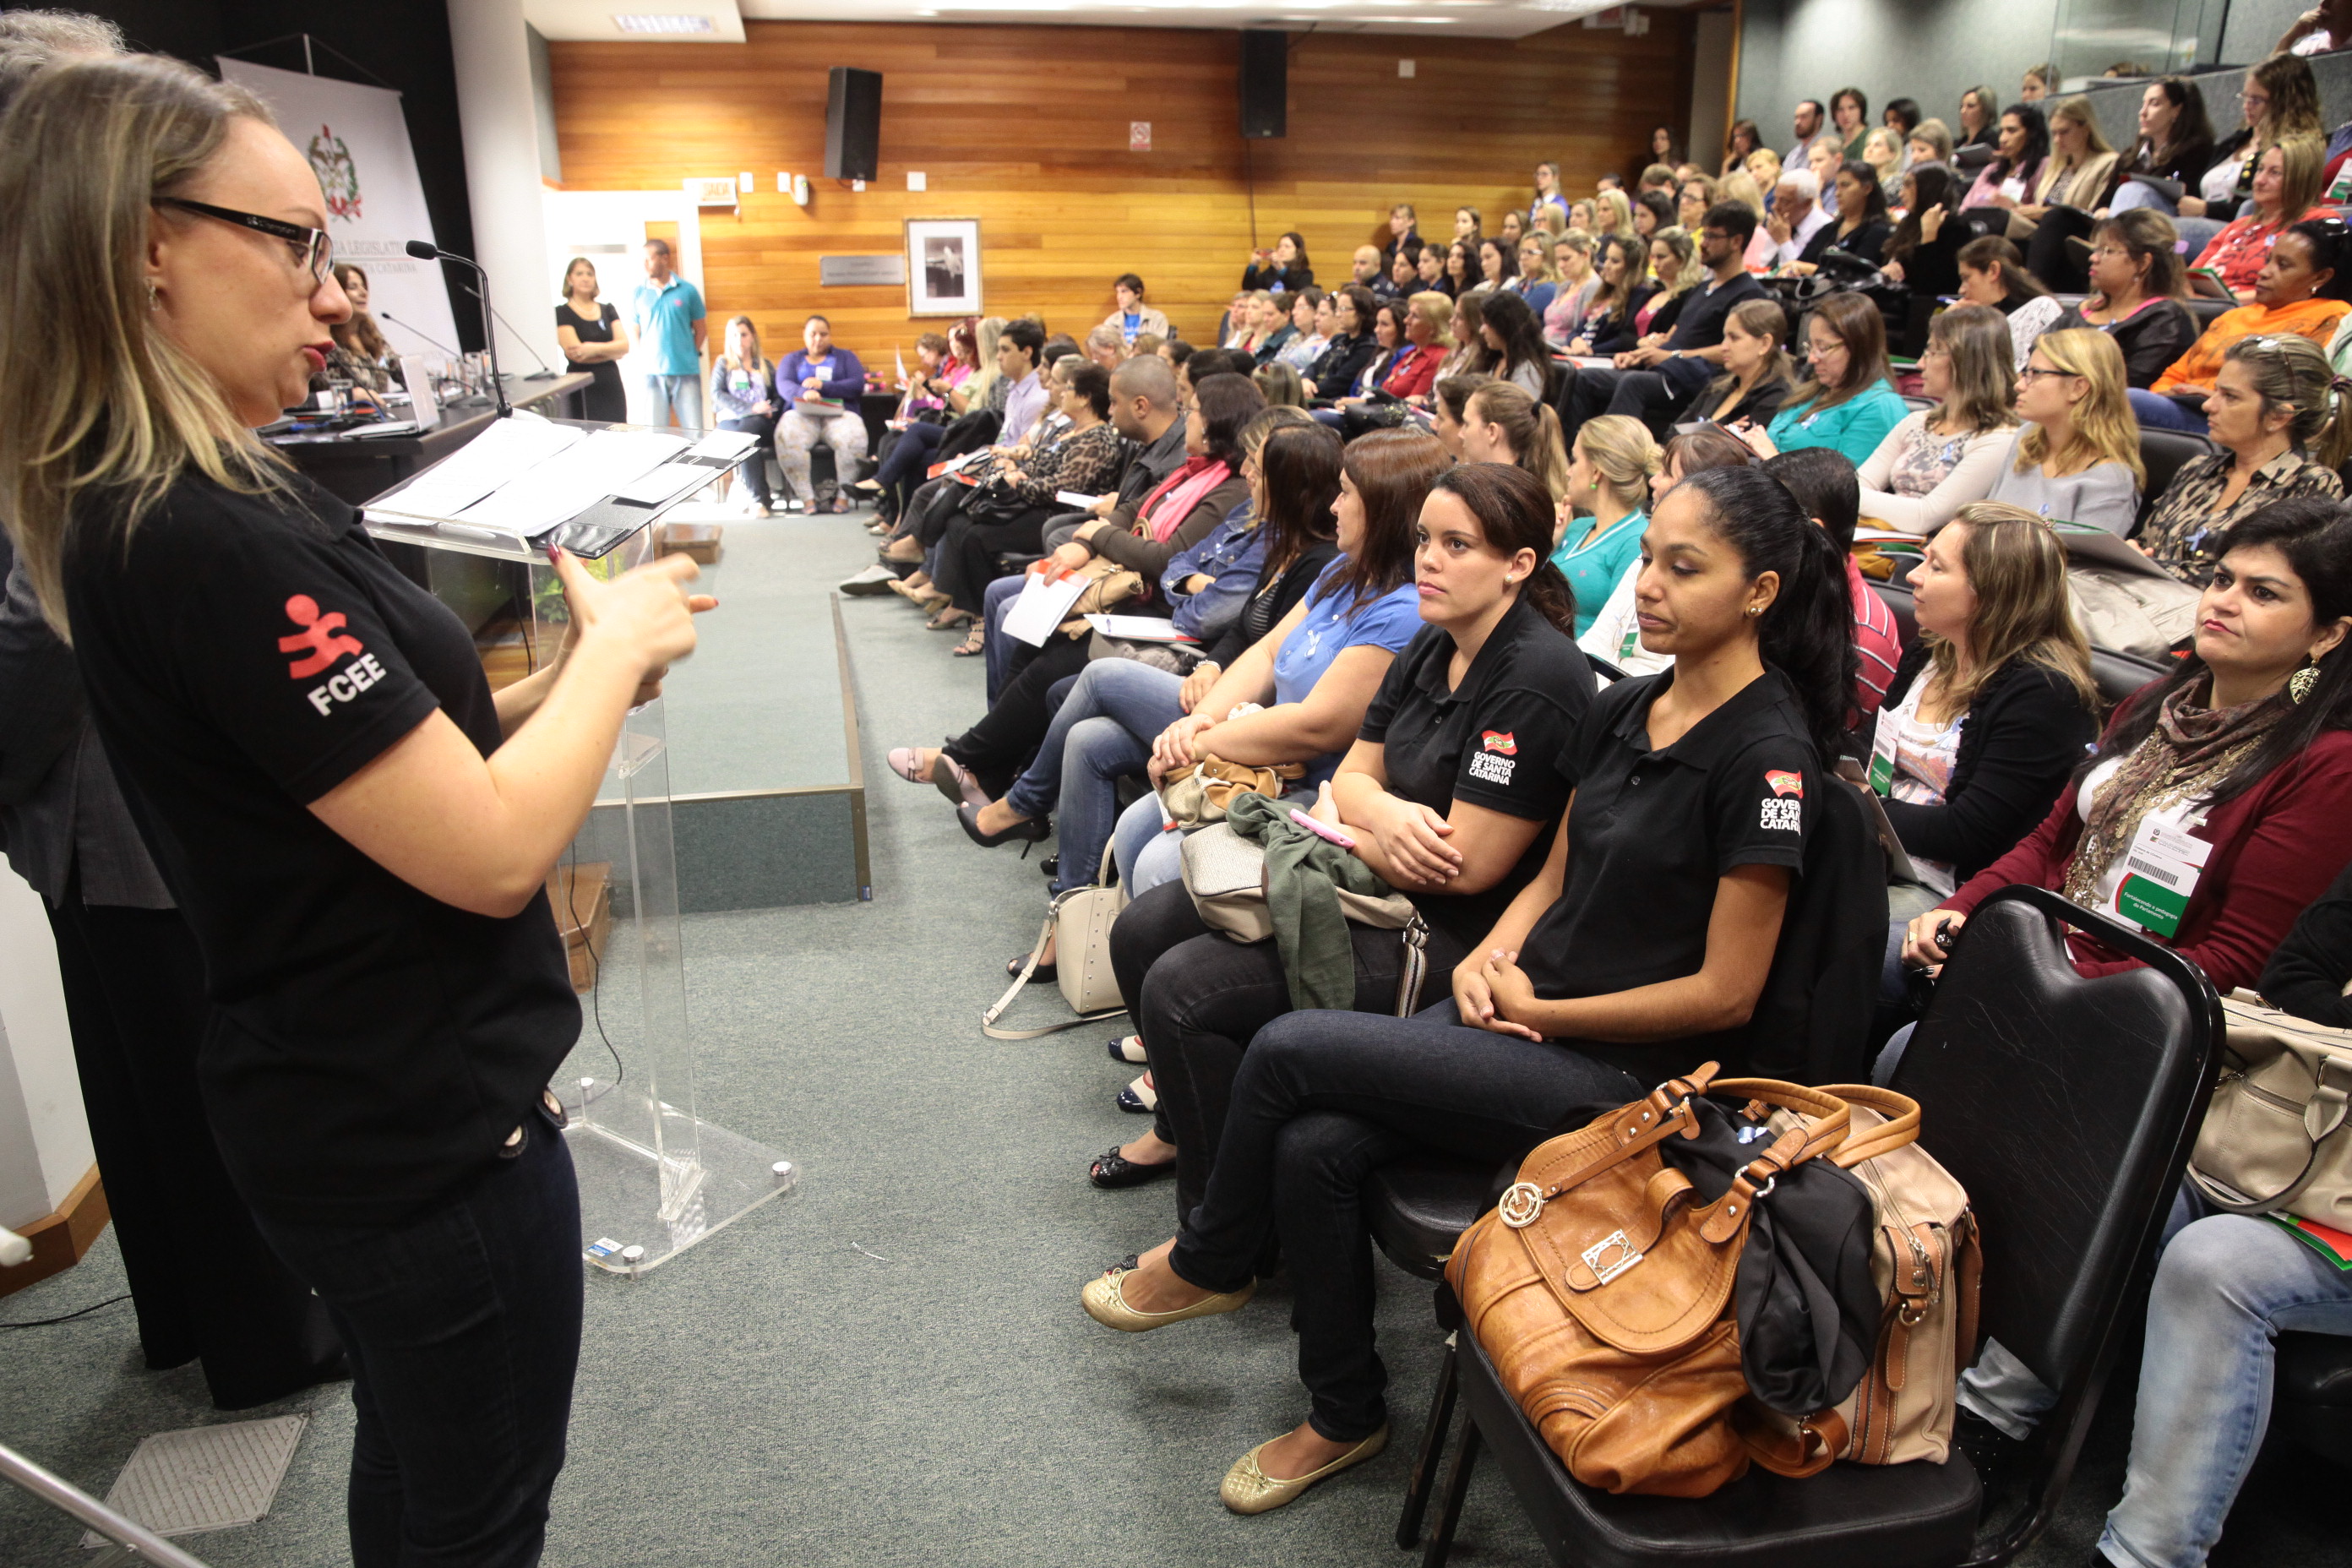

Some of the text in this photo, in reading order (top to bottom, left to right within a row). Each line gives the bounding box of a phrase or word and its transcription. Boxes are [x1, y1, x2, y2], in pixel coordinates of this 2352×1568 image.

[307, 653, 387, 716] FCEE
[1471, 760, 1512, 777] DE SANTA
[1474, 751, 1516, 770] GOVERNO
[1468, 767, 1511, 786] CATARINA
[1761, 798, 1800, 812] GOVER
[1761, 808, 1800, 823] DE SAN
[2123, 891, 2152, 908] Fortalecendo
[2155, 906, 2178, 920] pedagogia
[2139, 905, 2164, 920] Parlamento
